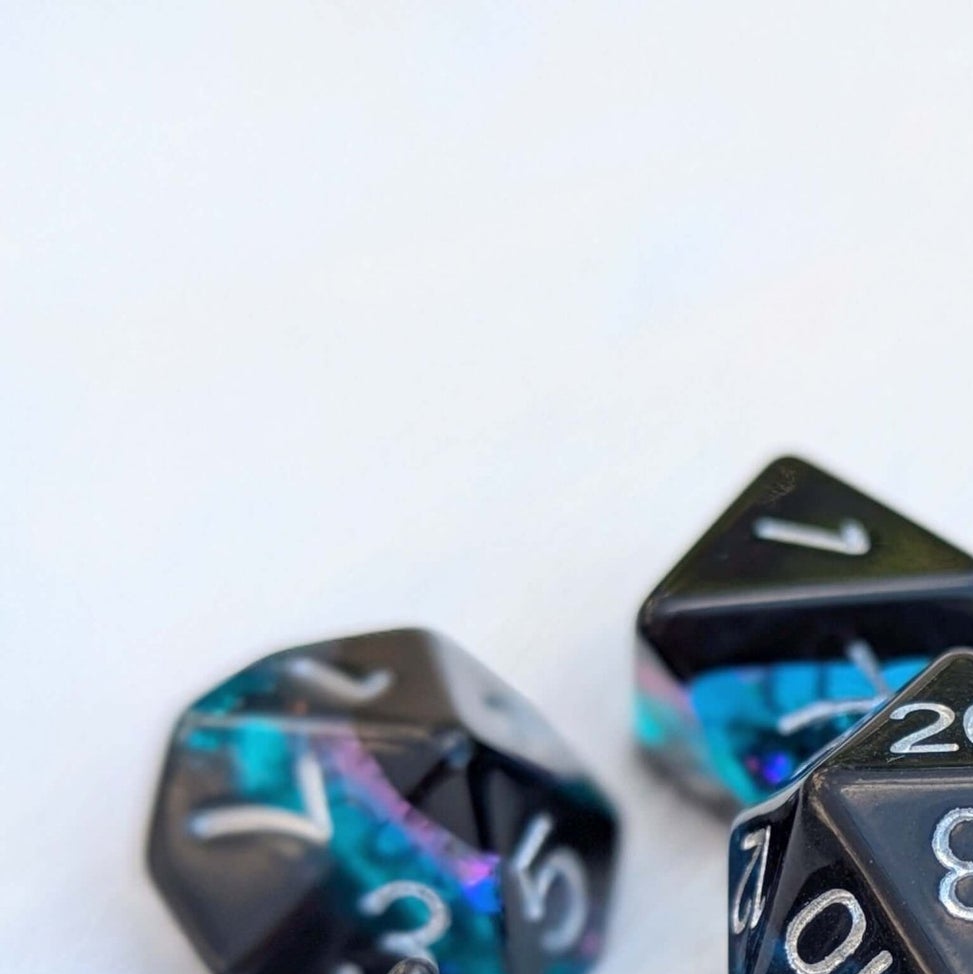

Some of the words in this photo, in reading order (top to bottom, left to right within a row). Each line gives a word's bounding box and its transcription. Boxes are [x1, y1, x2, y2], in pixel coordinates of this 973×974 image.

[753, 516, 870, 555] 1
[190, 750, 334, 845] 7
[511, 815, 589, 954] 5
